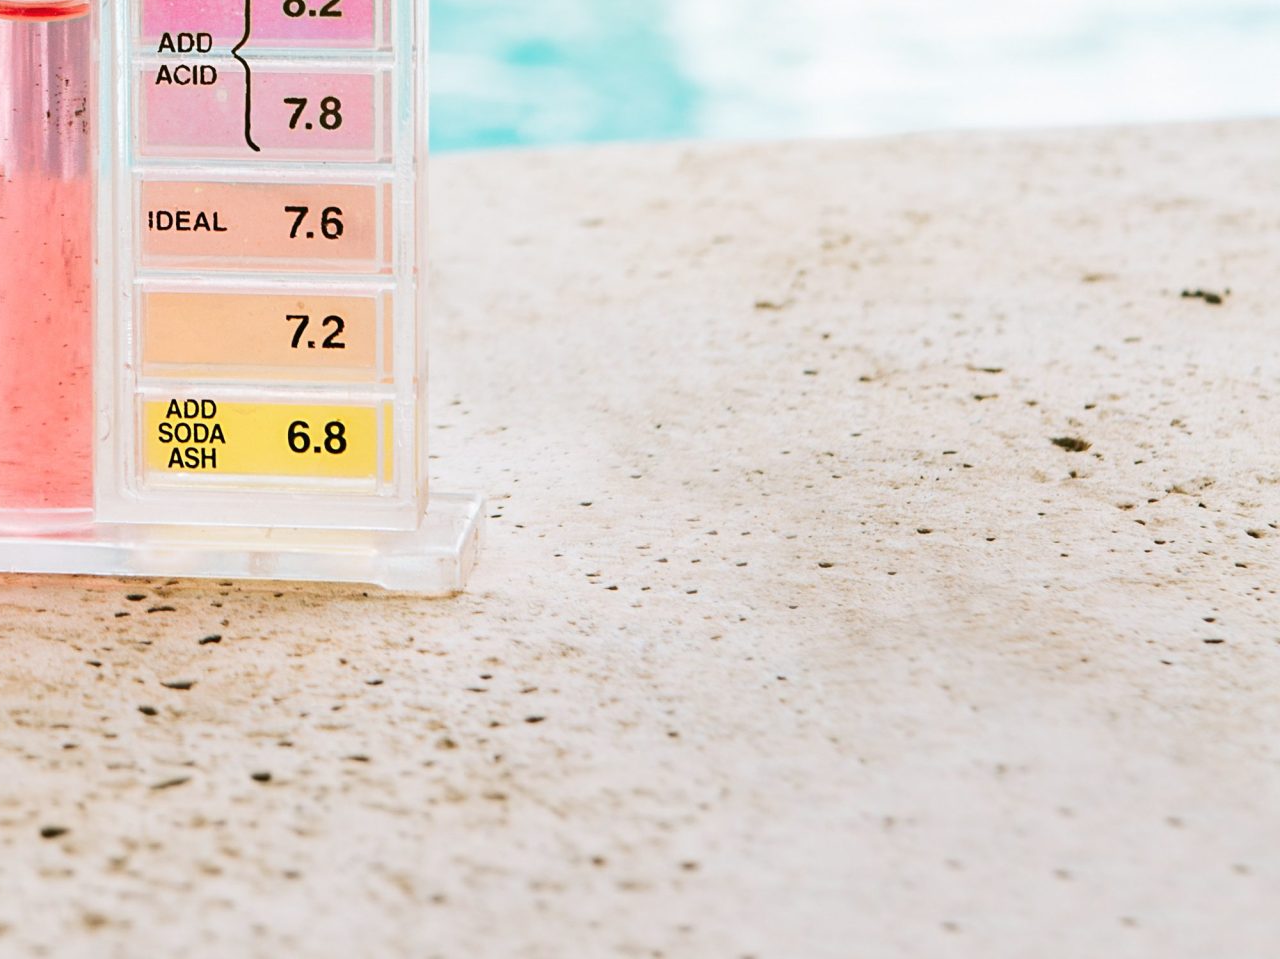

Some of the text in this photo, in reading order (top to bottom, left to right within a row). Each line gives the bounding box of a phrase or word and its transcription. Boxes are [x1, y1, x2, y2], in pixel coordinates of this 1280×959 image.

[157, 32, 213, 54] ADD
[155, 64, 218, 86] ACID
[283, 95, 343, 130] 7.8
[148, 210, 228, 232] IDEAL
[284, 205, 344, 240] 7.6
[285, 314, 346, 349] 7.2
[166, 398, 217, 419] ADD
[158, 422, 226, 444] SODA
[287, 420, 347, 455] 6.8
[167, 446, 217, 469] ASH
